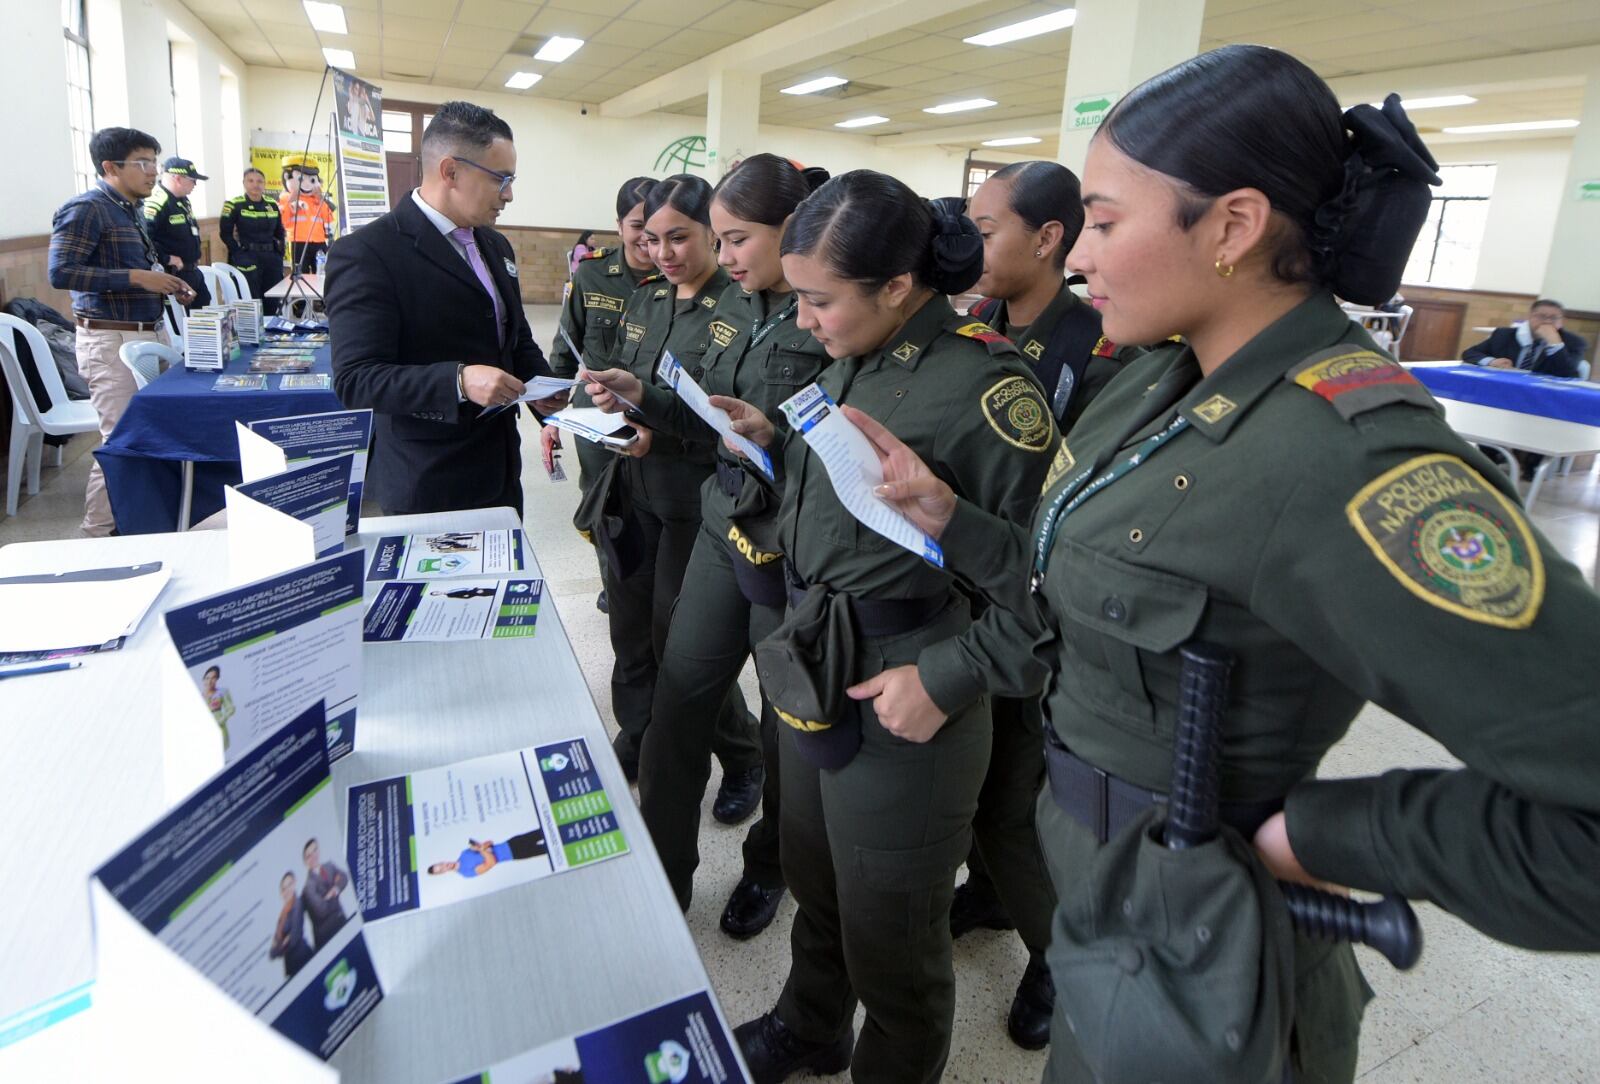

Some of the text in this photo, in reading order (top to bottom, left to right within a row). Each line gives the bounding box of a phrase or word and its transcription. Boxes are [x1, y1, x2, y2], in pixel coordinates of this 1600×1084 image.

[1377, 465, 1453, 510] POLICÍA
[1379, 478, 1480, 534] NACIONAL
[728, 525, 785, 565] POLIC
[275, 583, 291, 596] POR
